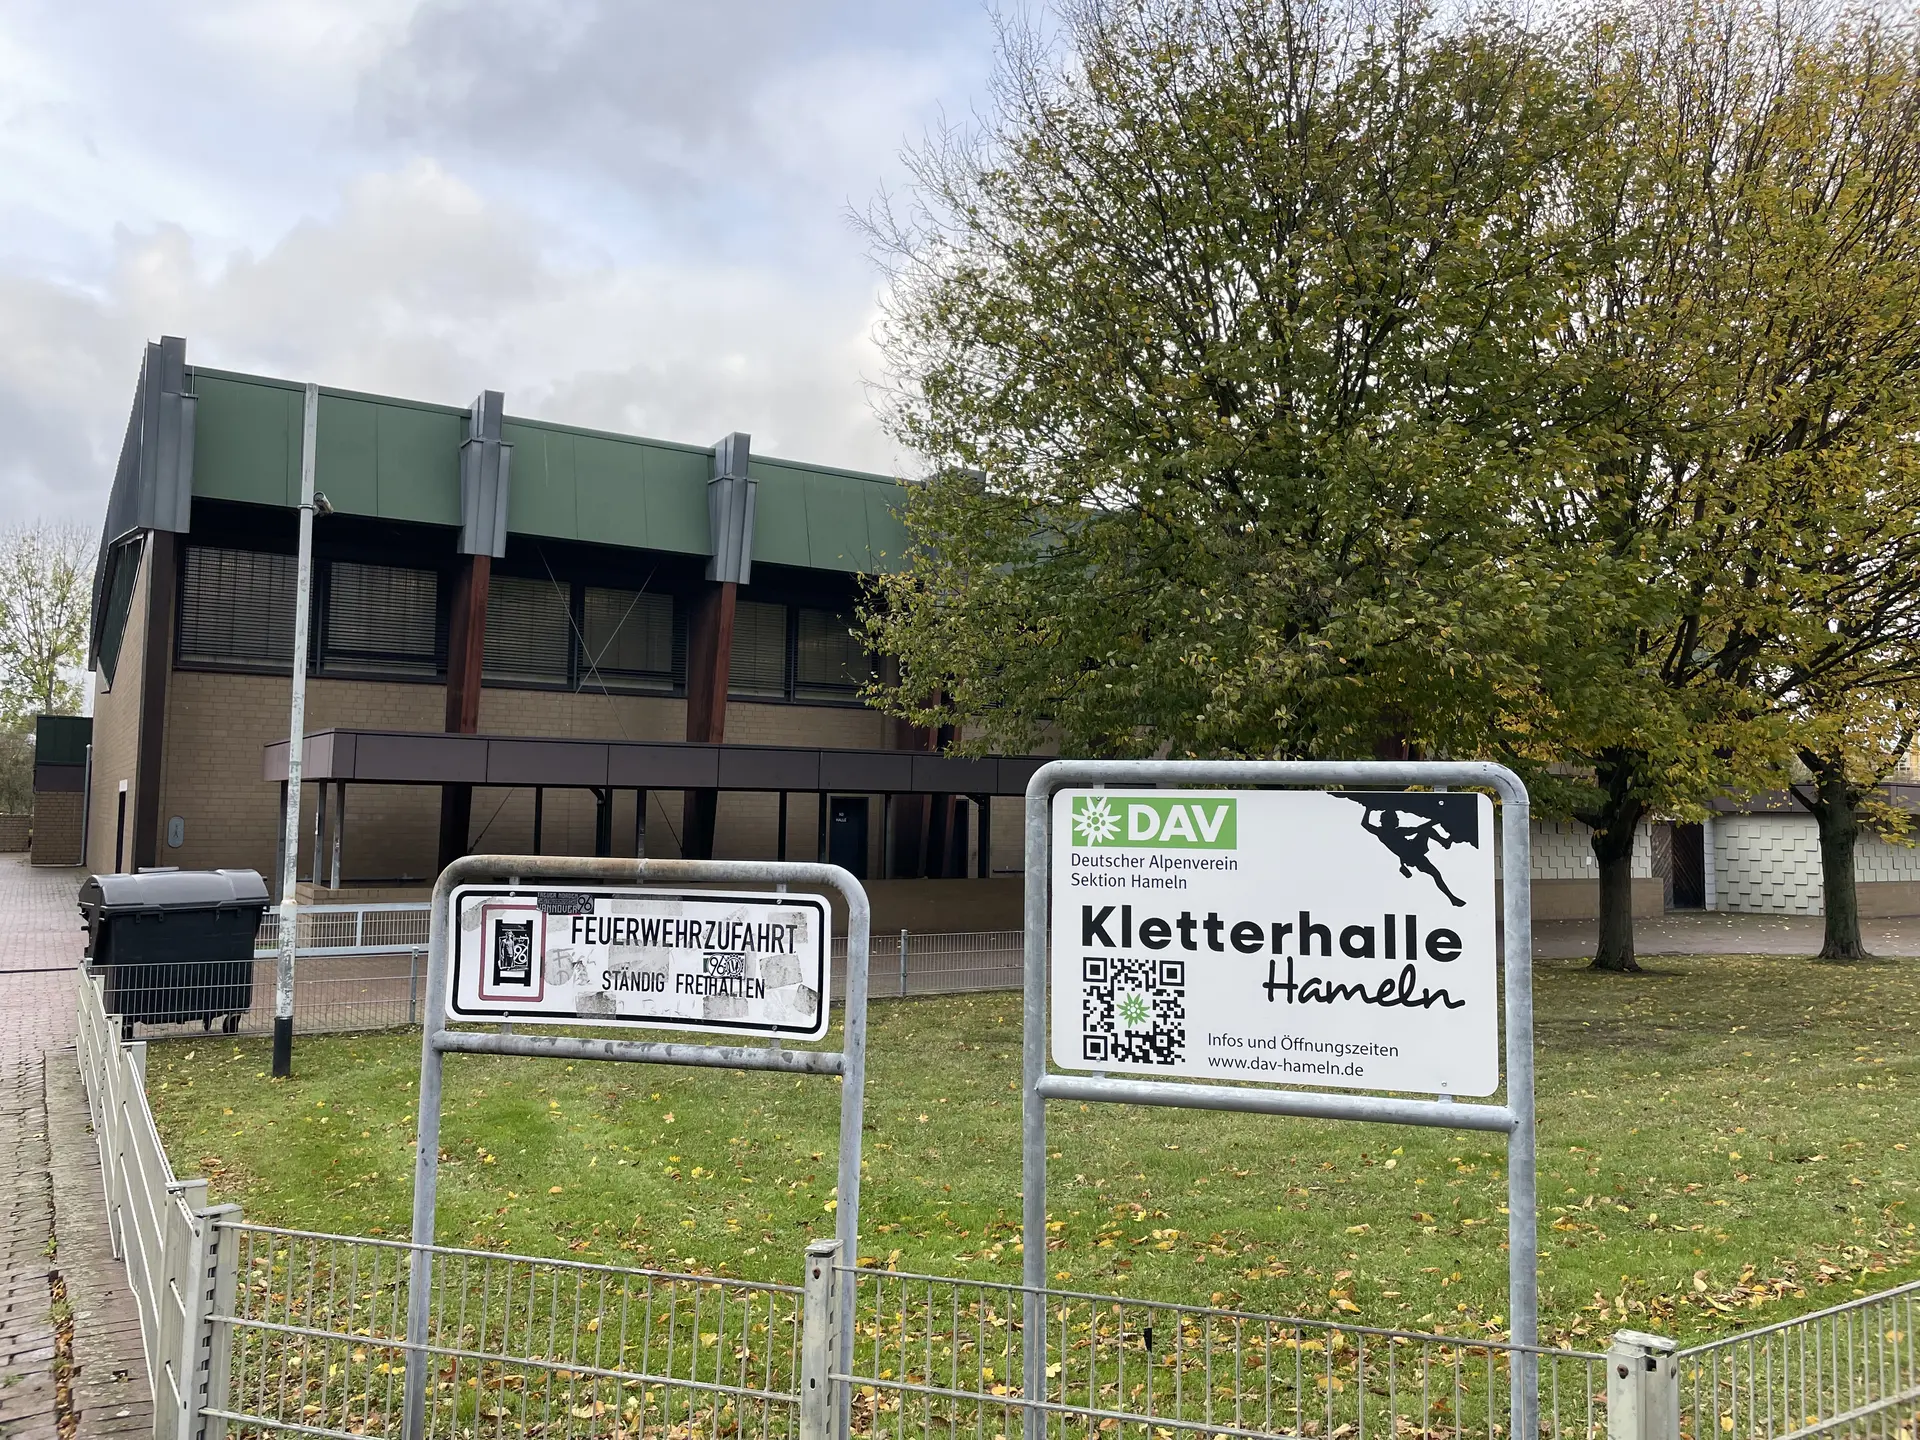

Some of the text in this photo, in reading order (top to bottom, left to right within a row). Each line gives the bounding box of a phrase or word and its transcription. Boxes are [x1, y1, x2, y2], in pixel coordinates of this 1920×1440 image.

[1127, 804, 1230, 843] DAV
[1071, 852, 1238, 874] Deutscher Alpenverein
[1071, 872, 1187, 890] Sektion Hameln
[571, 916, 798, 954] FEUERWEHRZUFAHRT
[1081, 904, 1463, 962] Kletterhalle
[602, 966, 765, 1000] STÄNDIG FREIHALTEN
[1262, 956, 1466, 1010] Hameln
[1207, 1032, 1399, 1058] Infos und Öffnungszeiten
[1207, 1056, 1365, 1077] www.dav-hameln.de
